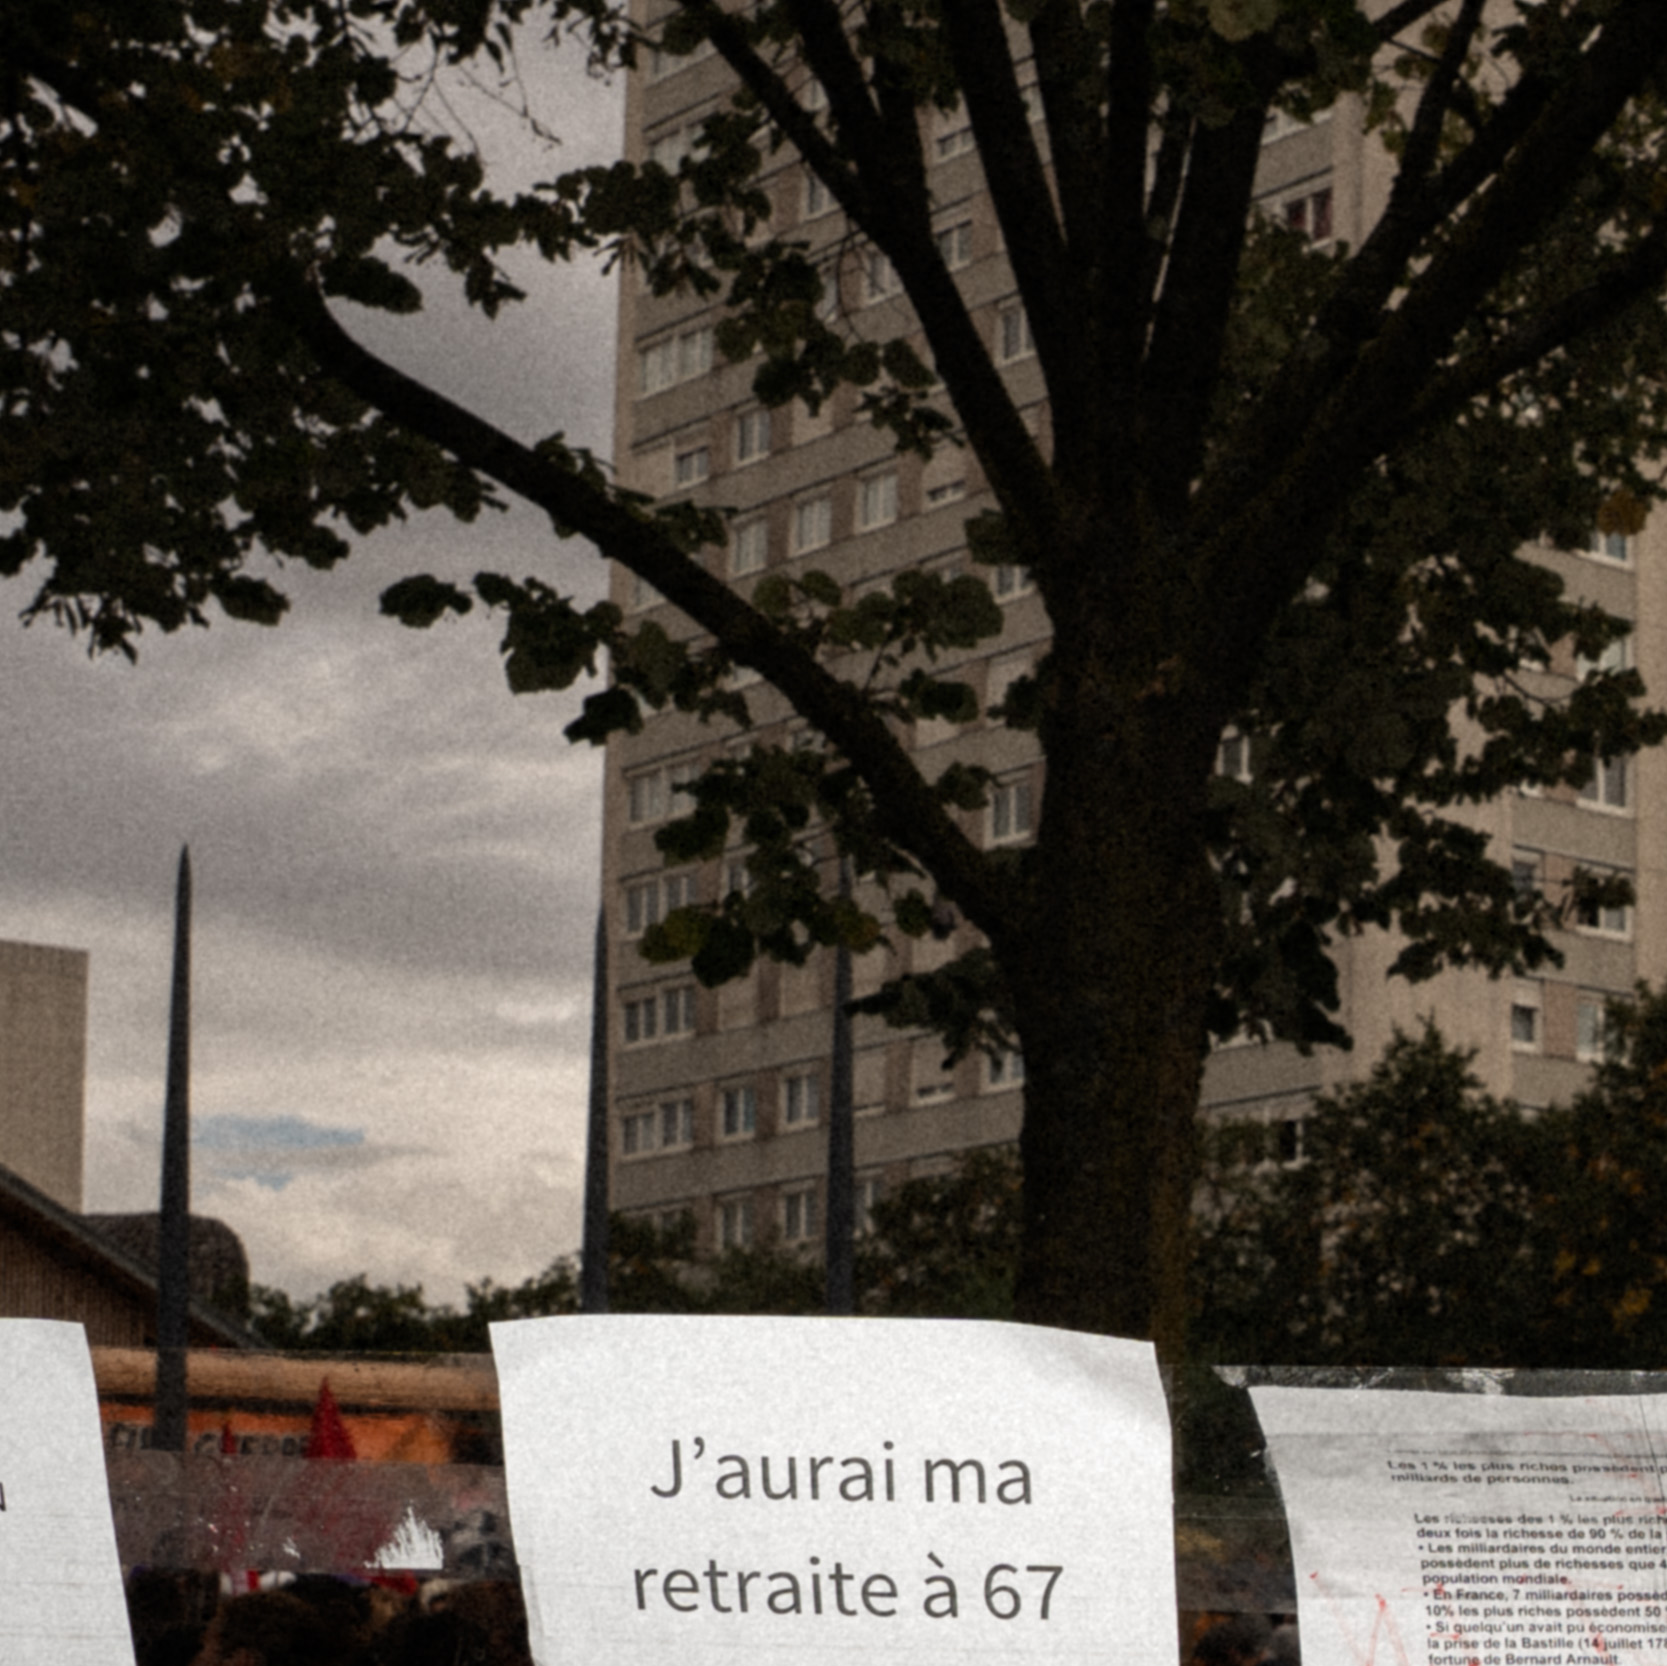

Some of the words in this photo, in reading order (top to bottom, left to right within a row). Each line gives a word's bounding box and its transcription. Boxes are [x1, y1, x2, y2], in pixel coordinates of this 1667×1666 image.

[651, 1437, 894, 1501] J'aurai
[925, 1459, 1031, 1504] ma
[1428, 1541, 1453, 1554] Les
[1458, 1541, 1546, 1554] milliardaires
[1572, 1541, 1621, 1554] monde
[635, 1557, 897, 1617] retraite
[924, 1552, 957, 1618] à
[985, 1564, 1063, 1619] 67
[1422, 1571, 1498, 1587] population
[1502, 1572, 1571, 1585] mondiale.
[1455, 1588, 1509, 1603] France,
[1512, 1588, 1520, 1601] 7
[1525, 1588, 1613, 1601] milliardaires
[1425, 1604, 1455, 1617] 10%
[1458, 1604, 1479, 1617] les
[1483, 1604, 1514, 1619] plus
[1517, 1604, 1562, 1617] riches
[1566, 1604, 1641, 1620] possèdent
[1645, 1604, 1661, 1617] 50
[1435, 1620, 1449, 1633] Si
[1453, 1620, 1524, 1635] quelqu'un
[1528, 1620, 1563, 1633] avait
[1566, 1623, 1585, 1635] pu
[1427, 1636, 1440, 1649] la
[1444, 1636, 1480, 1652] prise
[1483, 1636, 1501, 1649] de
[1504, 1636, 1517, 1649] la
[1521, 1636, 1574, 1649] Bastille
[1603, 1636, 1643, 1652] juillet
[1428, 1652, 1480, 1665] fortune
[1483, 1652, 1501, 1665] de
[1505, 1652, 1562, 1665] Bernard
